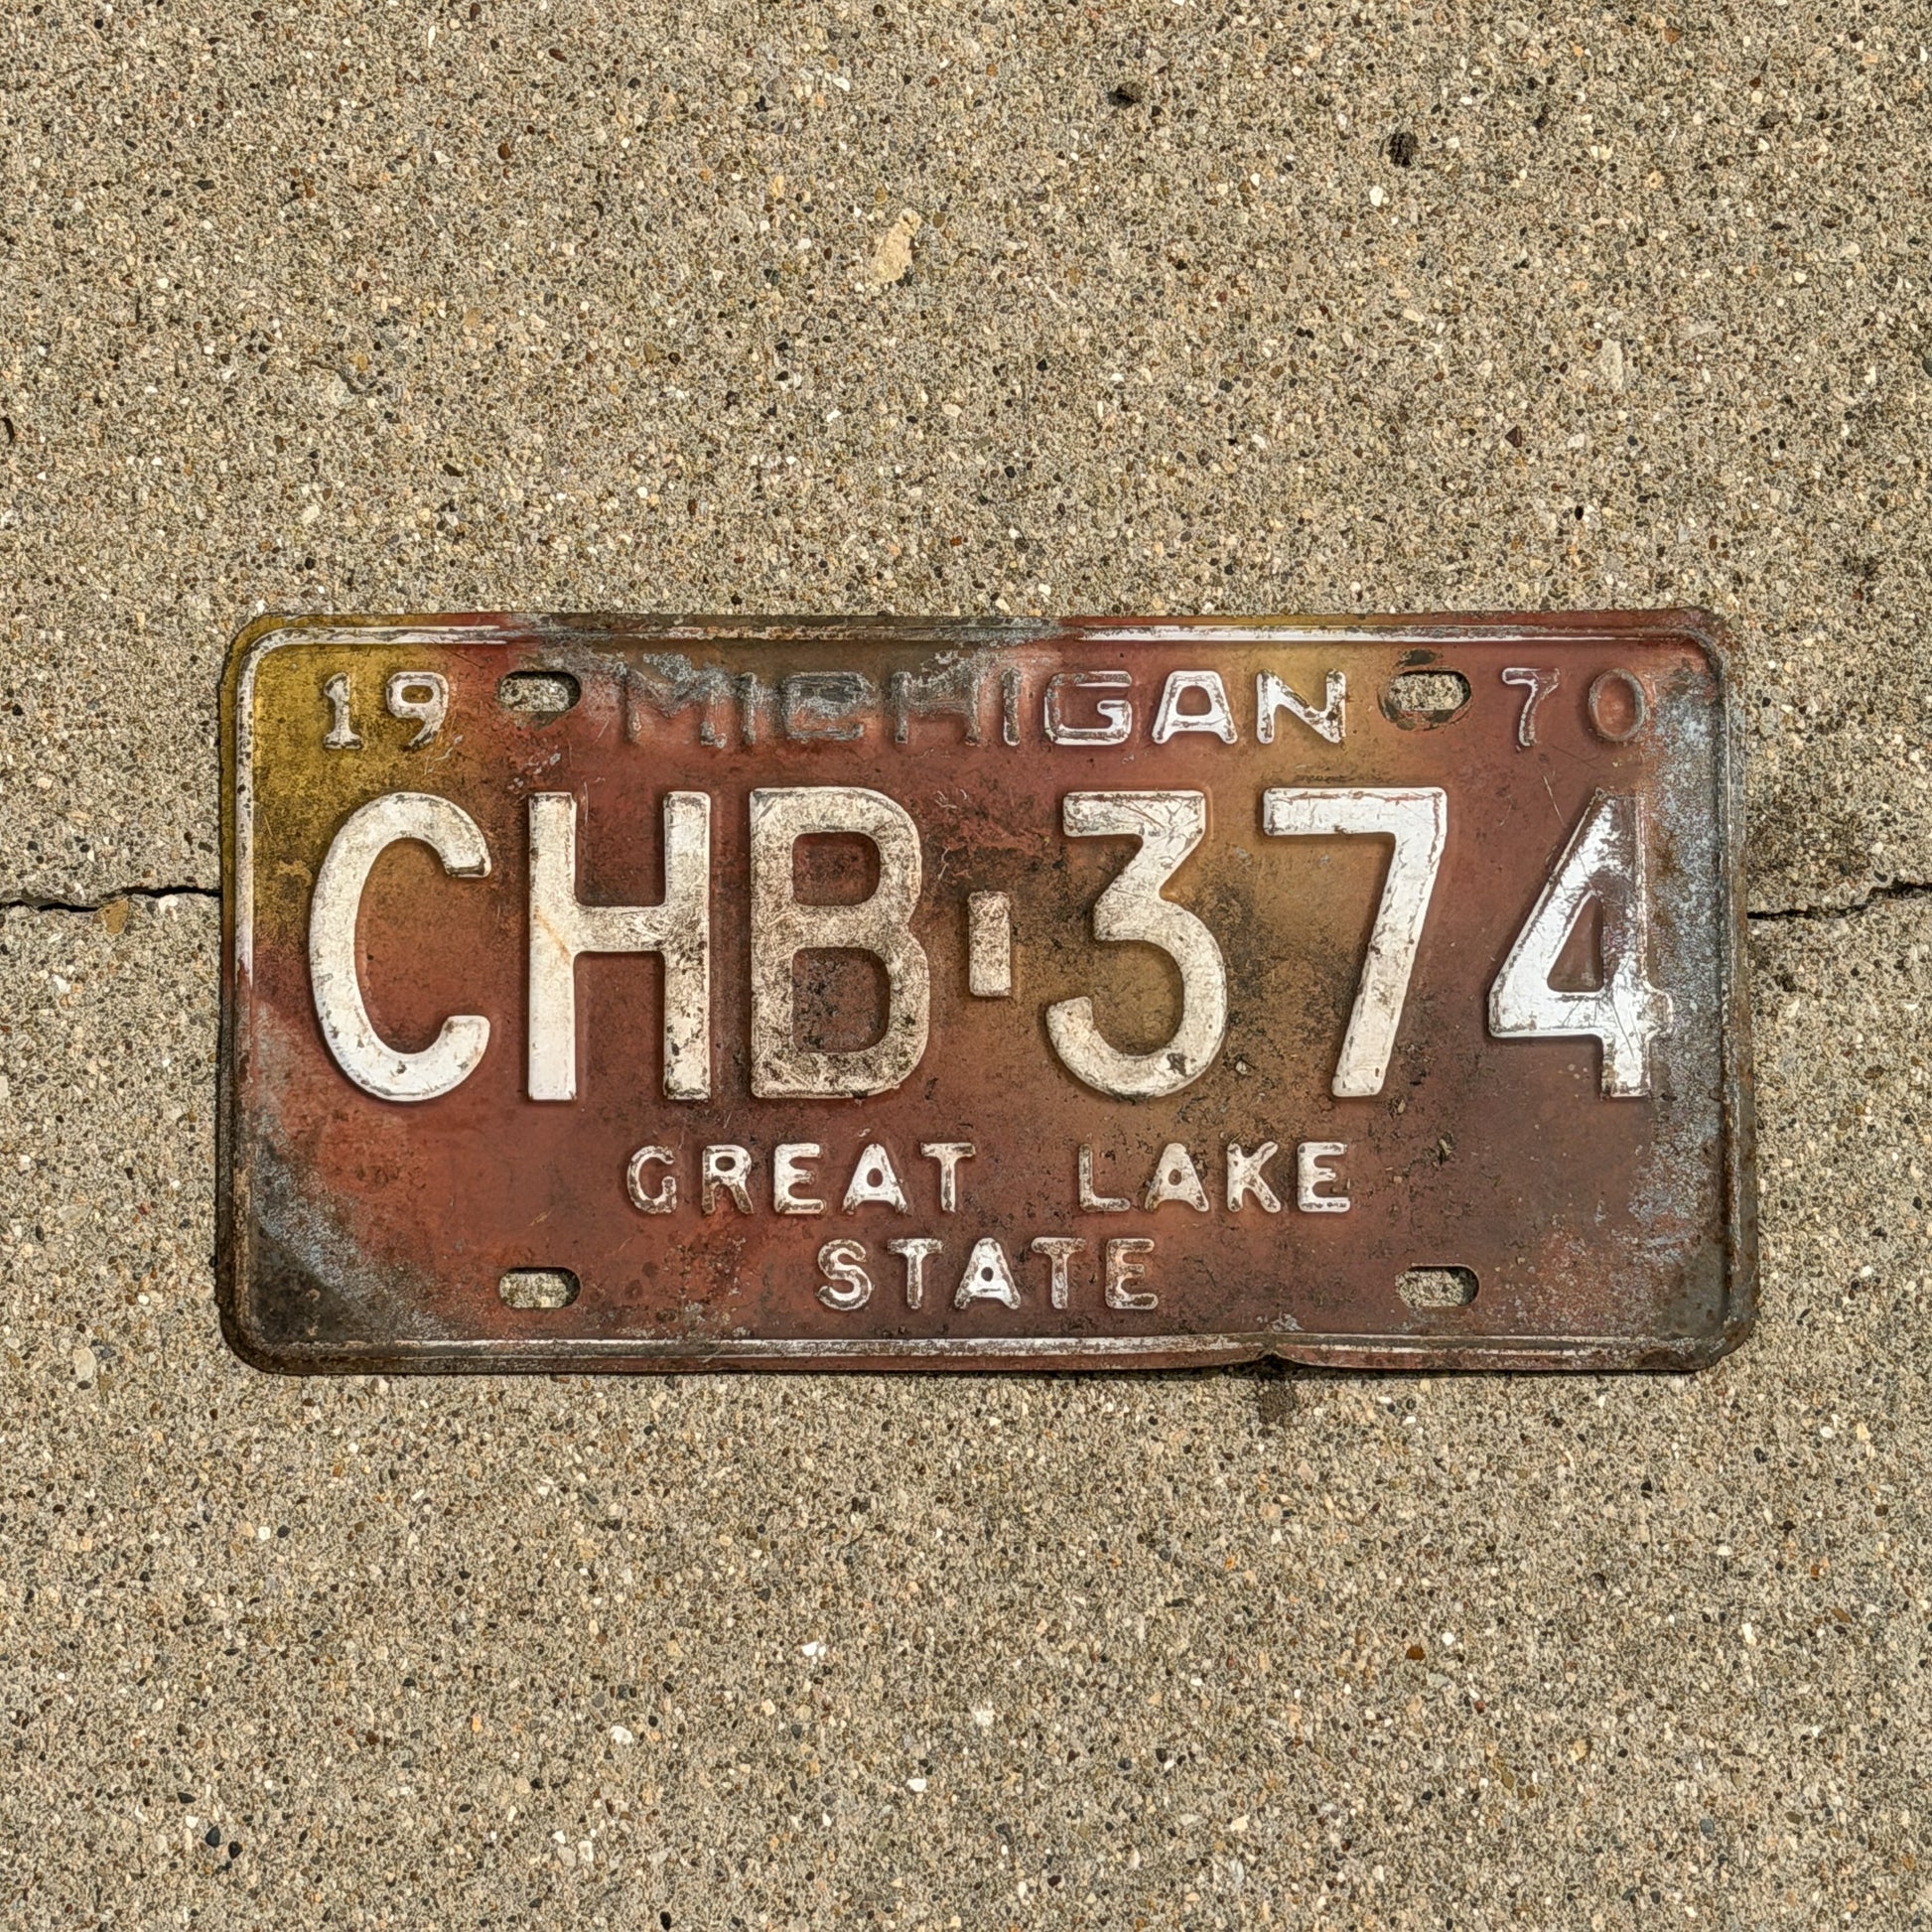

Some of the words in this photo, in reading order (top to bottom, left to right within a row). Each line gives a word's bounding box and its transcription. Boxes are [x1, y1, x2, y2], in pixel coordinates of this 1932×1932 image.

[323, 671, 450, 751] 19
[1501, 667, 1647, 745] 70
[626, 1142, 975, 1215] GREAT
[1078, 1141, 1352, 1214] LAKE
[817, 1237, 1160, 1311] STATE
